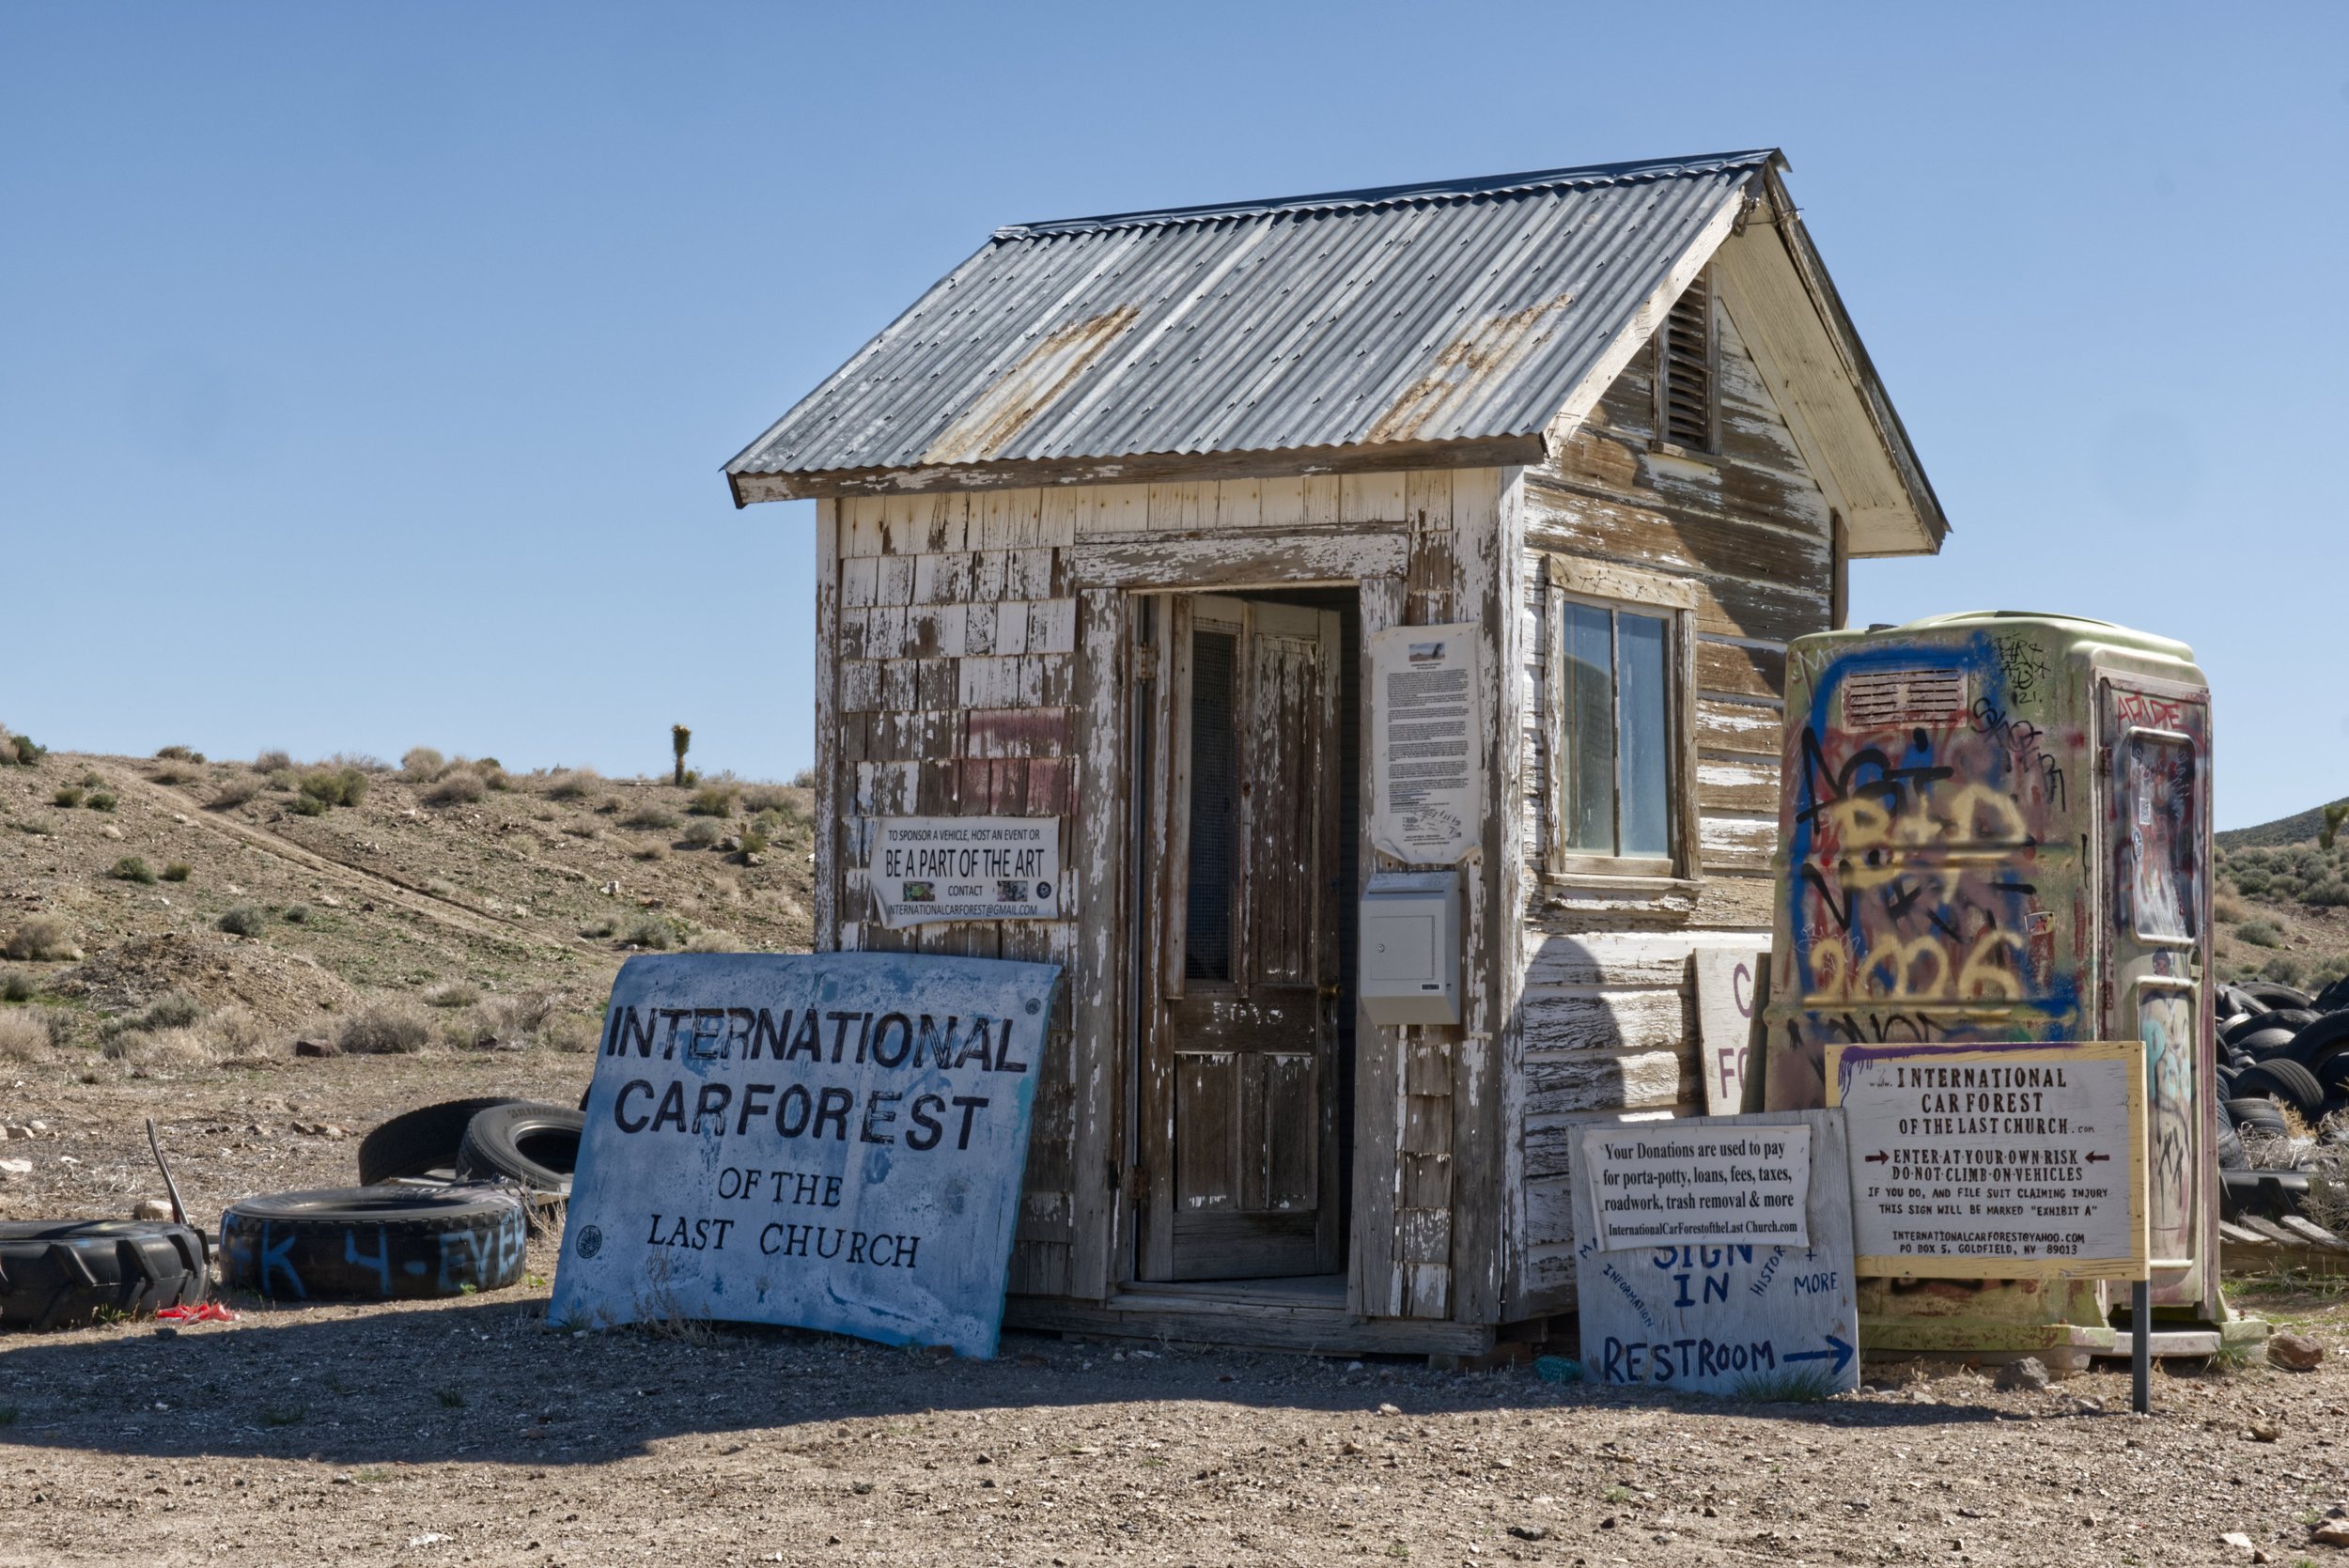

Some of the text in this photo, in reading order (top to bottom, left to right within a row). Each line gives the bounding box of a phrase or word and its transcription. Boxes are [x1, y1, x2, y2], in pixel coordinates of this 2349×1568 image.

[889, 830, 1039, 842] TO SPONSOR A VEHICLE, HOST AN EVENT OR
[886, 849, 1045, 877] BE A PART OF THE ART
[948, 885, 983, 896] CONTACT
[606, 1003, 1027, 1072] INTERNATIONAL
[1897, 1067, 2067, 1088] INTERNATIONAL
[1899, 1118, 1918, 1135] OF
[1923, 1118, 1952, 1134] THE
[1958, 1117, 1999, 1134] LAST
[1605, 1140, 1785, 1159] Your Donations are used to pay
[718, 1167, 843, 1207] OF THE
[1603, 1165, 1792, 1189] for porta-potty, loans, fees, taxes,
[1605, 1190, 1794, 1213] roadwork, trash removal & more
[1868, 1188, 2108, 1199] IF YOU DO, AND FILE SUIT CLAIMING INJURY
[1879, 1204, 2097, 1216] THIS SIGN WILL BE MARKED "EXHIBIT A"
[647, 1215, 734, 1250] LAST
[759, 1223, 921, 1267] CHURCH
[1900, 1244, 1912, 1253] PO
[1918, 1245, 1935, 1253] BOX
[1958, 1244, 2017, 1255] GOLDFIELD,
[2024, 1245, 2036, 1254] NV
[2046, 1245, 2077, 1254] 89013
[261, 1221, 306, 1298] K
[1603, 1263, 1655, 1327] INFORMATION
[1673, 1272, 1729, 1307] IN
[1794, 1271, 1837, 1296] MORE
[1604, 1336, 1775, 1384] RESTROOM
